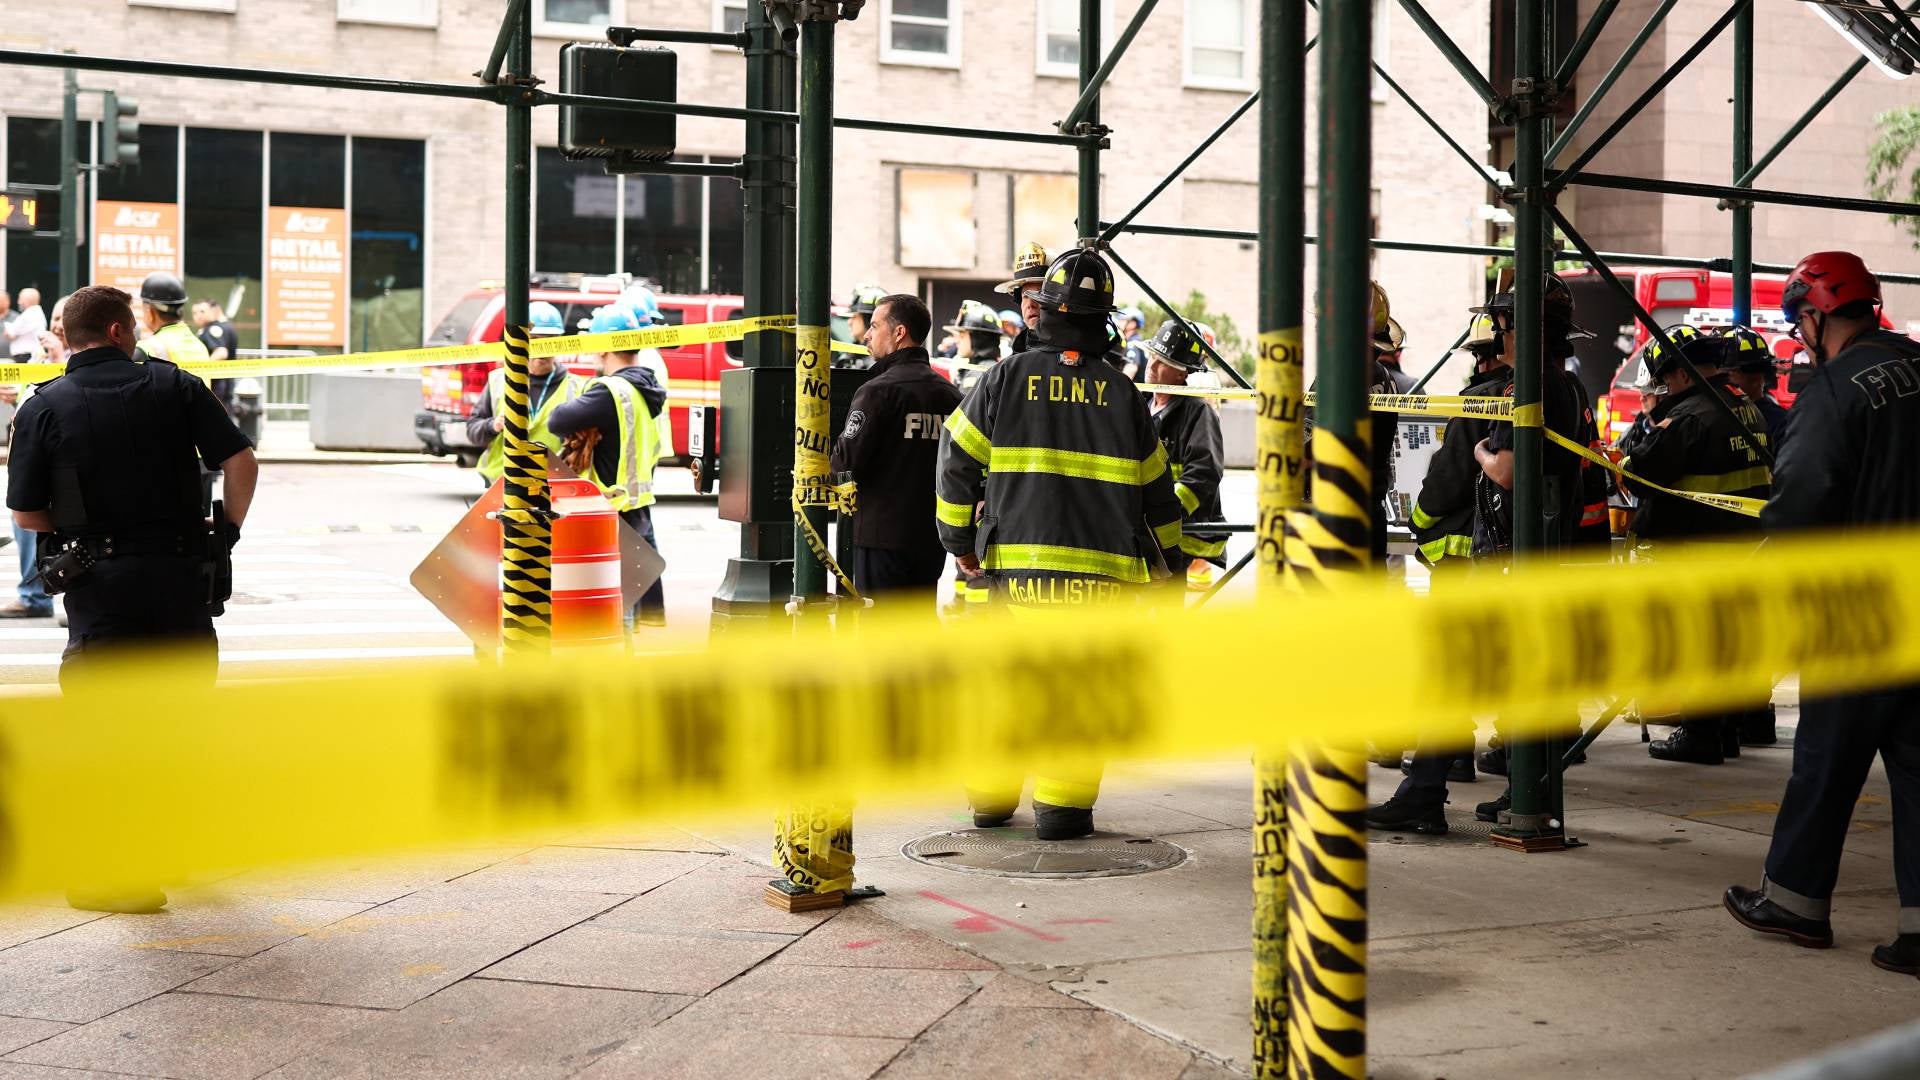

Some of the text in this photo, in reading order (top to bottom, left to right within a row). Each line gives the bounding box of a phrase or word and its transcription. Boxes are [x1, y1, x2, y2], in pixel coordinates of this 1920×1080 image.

[22, 199, 36, 226] 4
[98, 233, 175, 255] RETAIL
[270, 237, 342, 259] RETAIL
[98, 254, 175, 271] FOR LEASE
[270, 259, 342, 274] FOR LEASE
[1162, 330, 1172, 343] 8
[1850, 357, 1920, 410] FD
[1387, 396, 1398, 408] DO
[1397, 396, 1413, 410] LINE
[1412, 396, 1430, 410] FIRE
[1462, 398, 1510, 416] DO NOT CROSS
[1008, 577, 1121, 606] McALLISTER
